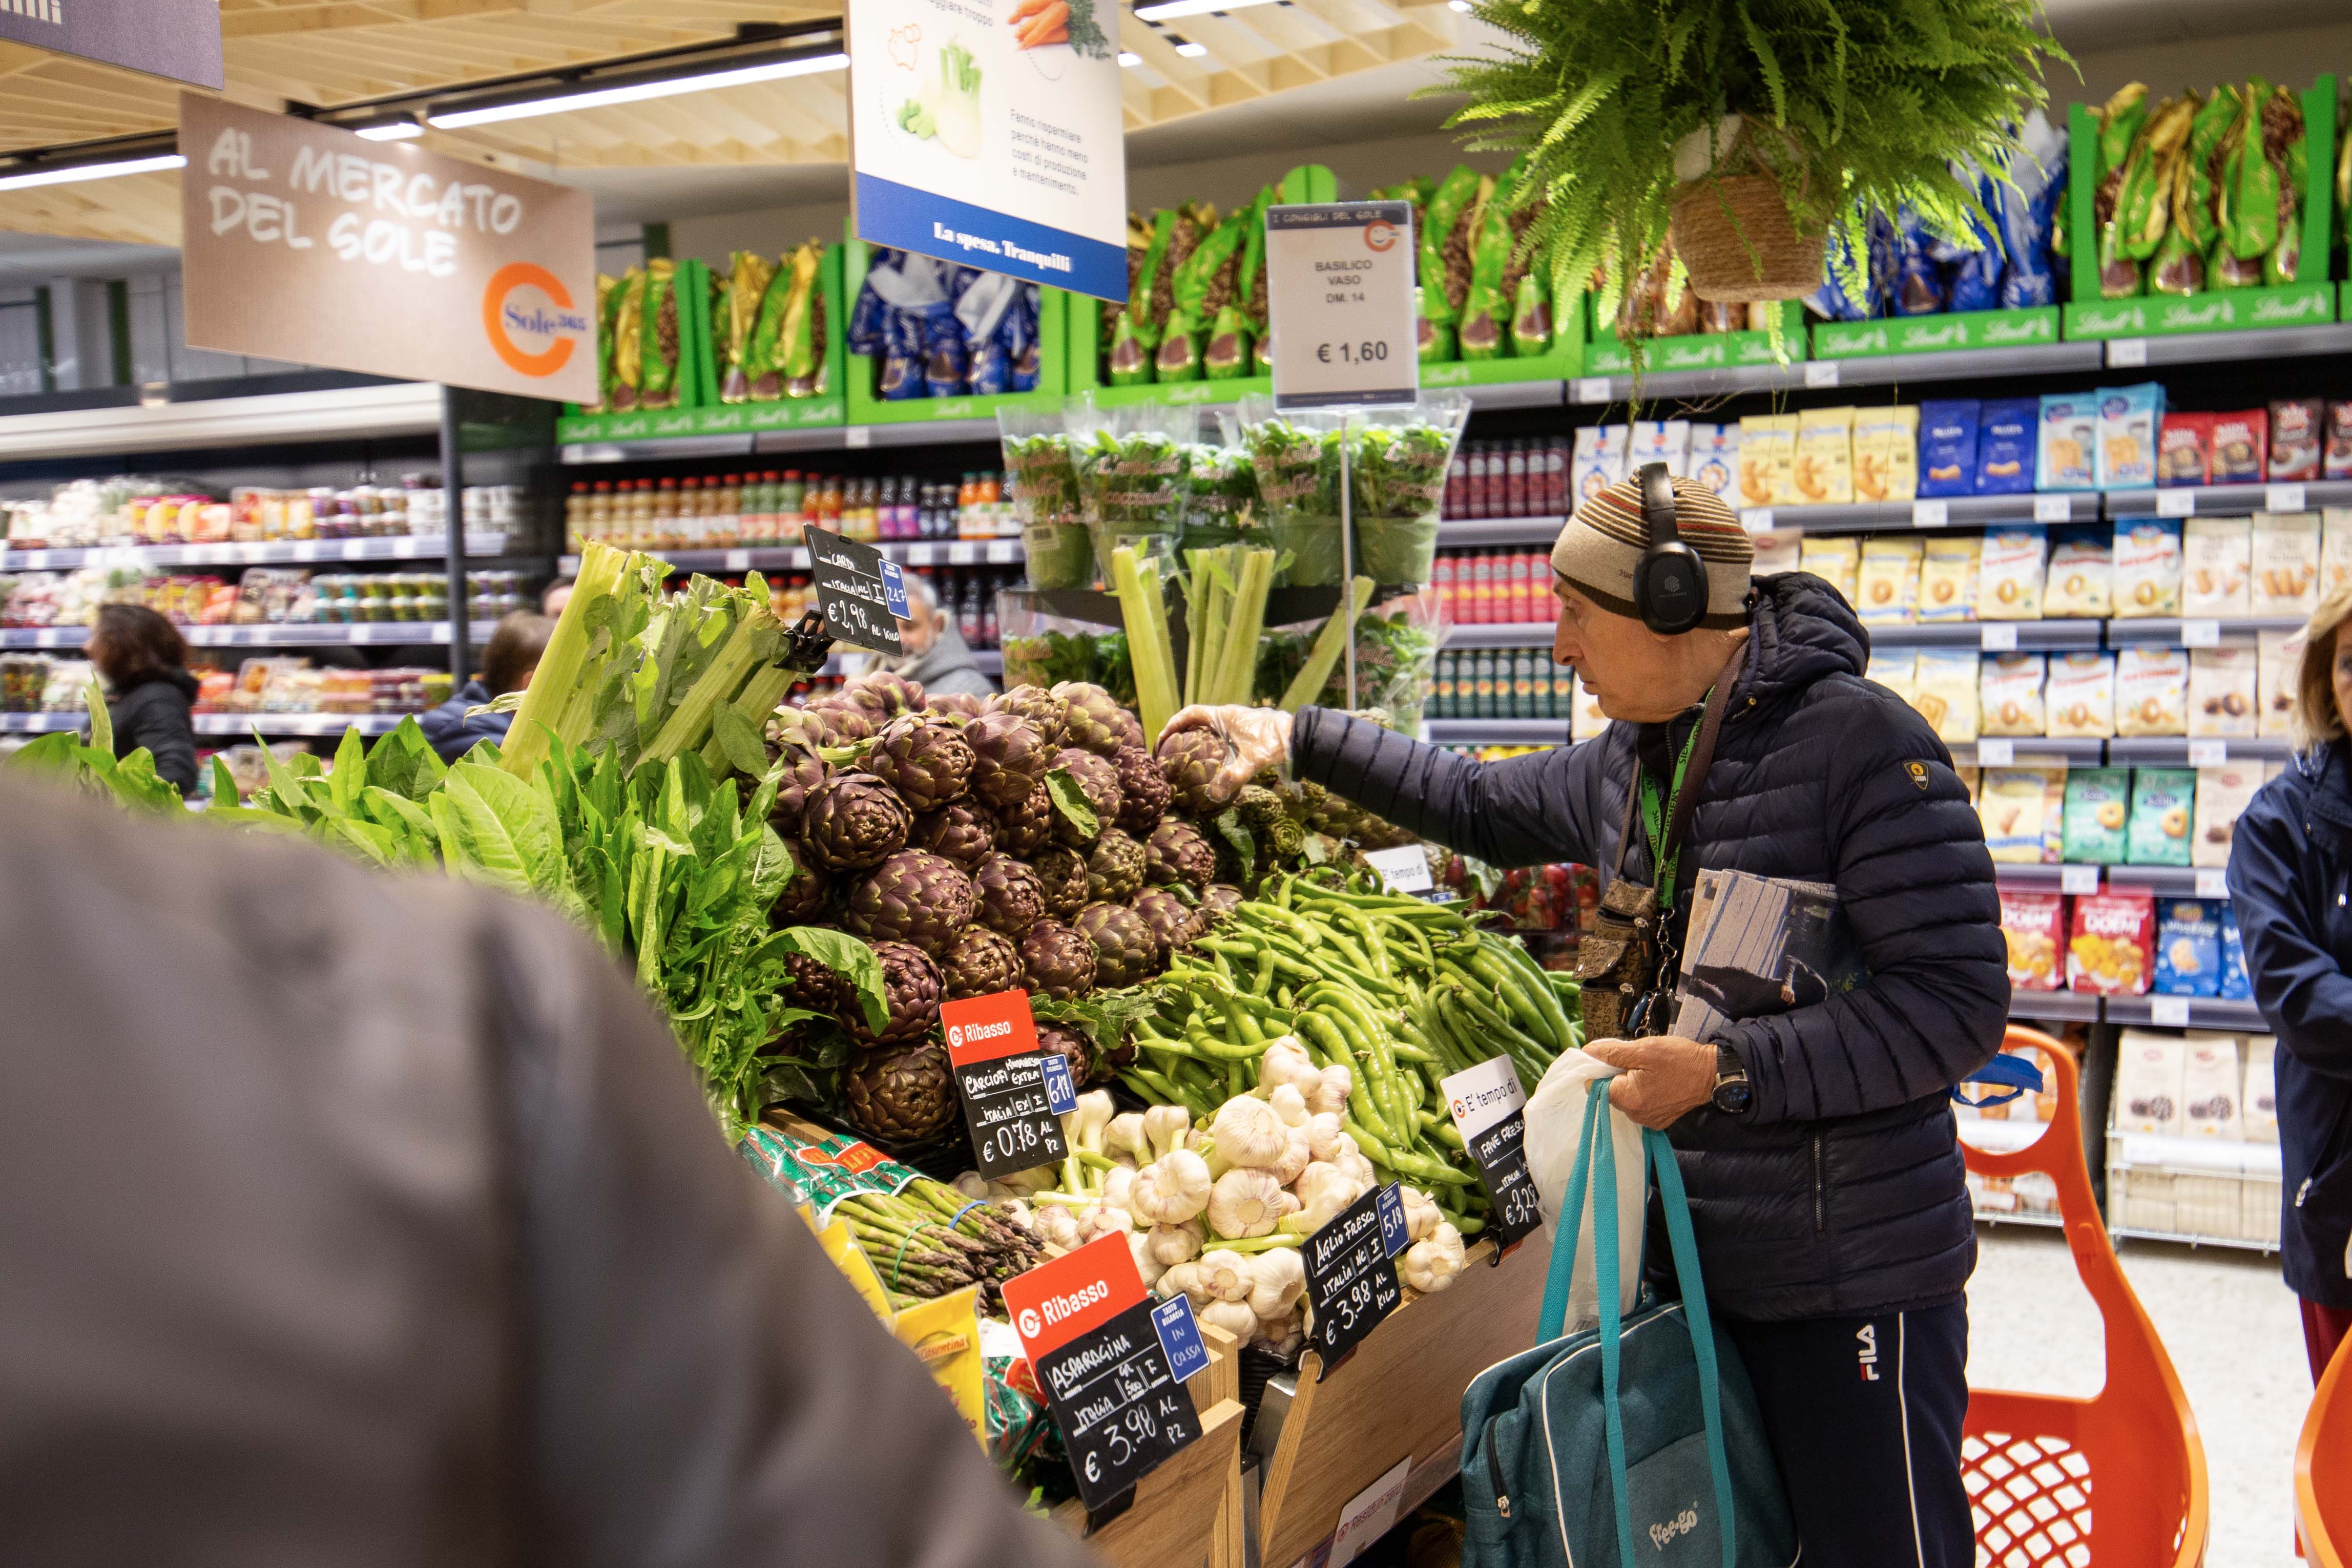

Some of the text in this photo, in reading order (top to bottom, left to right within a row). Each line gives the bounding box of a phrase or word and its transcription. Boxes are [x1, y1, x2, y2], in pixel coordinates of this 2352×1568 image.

[965, 7, 992, 26] troppo
[1010, 109, 1082, 143] Fanno risparmiare
[1041, 138, 1066, 156] hanno
[1068, 149, 1088, 163] meno
[1012, 149, 1086, 180] costi di produzione
[209, 127, 521, 235] AL MERCATO
[1013, 168, 1078, 195] e mantenimento.
[1333, 212, 1351, 220] DEL
[210, 187, 456, 278] DEL SOLE
[933, 221, 1071, 273] La spesa. Tranquilli
[1315, 259, 1373, 271] BASILICO
[1327, 275, 1361, 285] VASO
[1352, 292, 1365, 302] 14
[1317, 341, 1388, 366] € 1,60
[831, 554, 855, 570] CARDI
[887, 586, 905, 603] 217
[827, 600, 900, 641] € 2,98 AL KILO
[1390, 867, 1416, 881] tempo
[964, 1021, 1011, 1042] Ribasso
[1011, 1070, 1039, 1085] EXTRA
[1048, 1074, 1071, 1104] 617
[1476, 1085, 1507, 1107] tempo
[1507, 1078, 1518, 1095] di
[983, 1141, 994, 1162] €
[1040, 1121, 1053, 1136] AL
[1045, 1138, 1058, 1154] PZ
[1481, 1135, 1501, 1158] FAVE
[1501, 1170, 1520, 1186] ITALIA
[1343, 1211, 1376, 1241] FRESCO
[1383, 1206, 1403, 1238] 518
[1506, 1205, 1515, 1226] €
[1042, 1280, 1109, 1326] Ribasso
[1162, 1302, 1177, 1316] TASTO
[1326, 1320, 1336, 1345] €
[1375, 1272, 1387, 1288] AL
[1161, 1308, 1184, 1327] BILANCIA
[1172, 1327, 1185, 1342] IN
[1173, 1344, 1201, 1367] CASSA
[1085, 1450, 1100, 1483] €
[1159, 1395, 1179, 1417] AL
[1167, 1423, 1186, 1444] PZ
